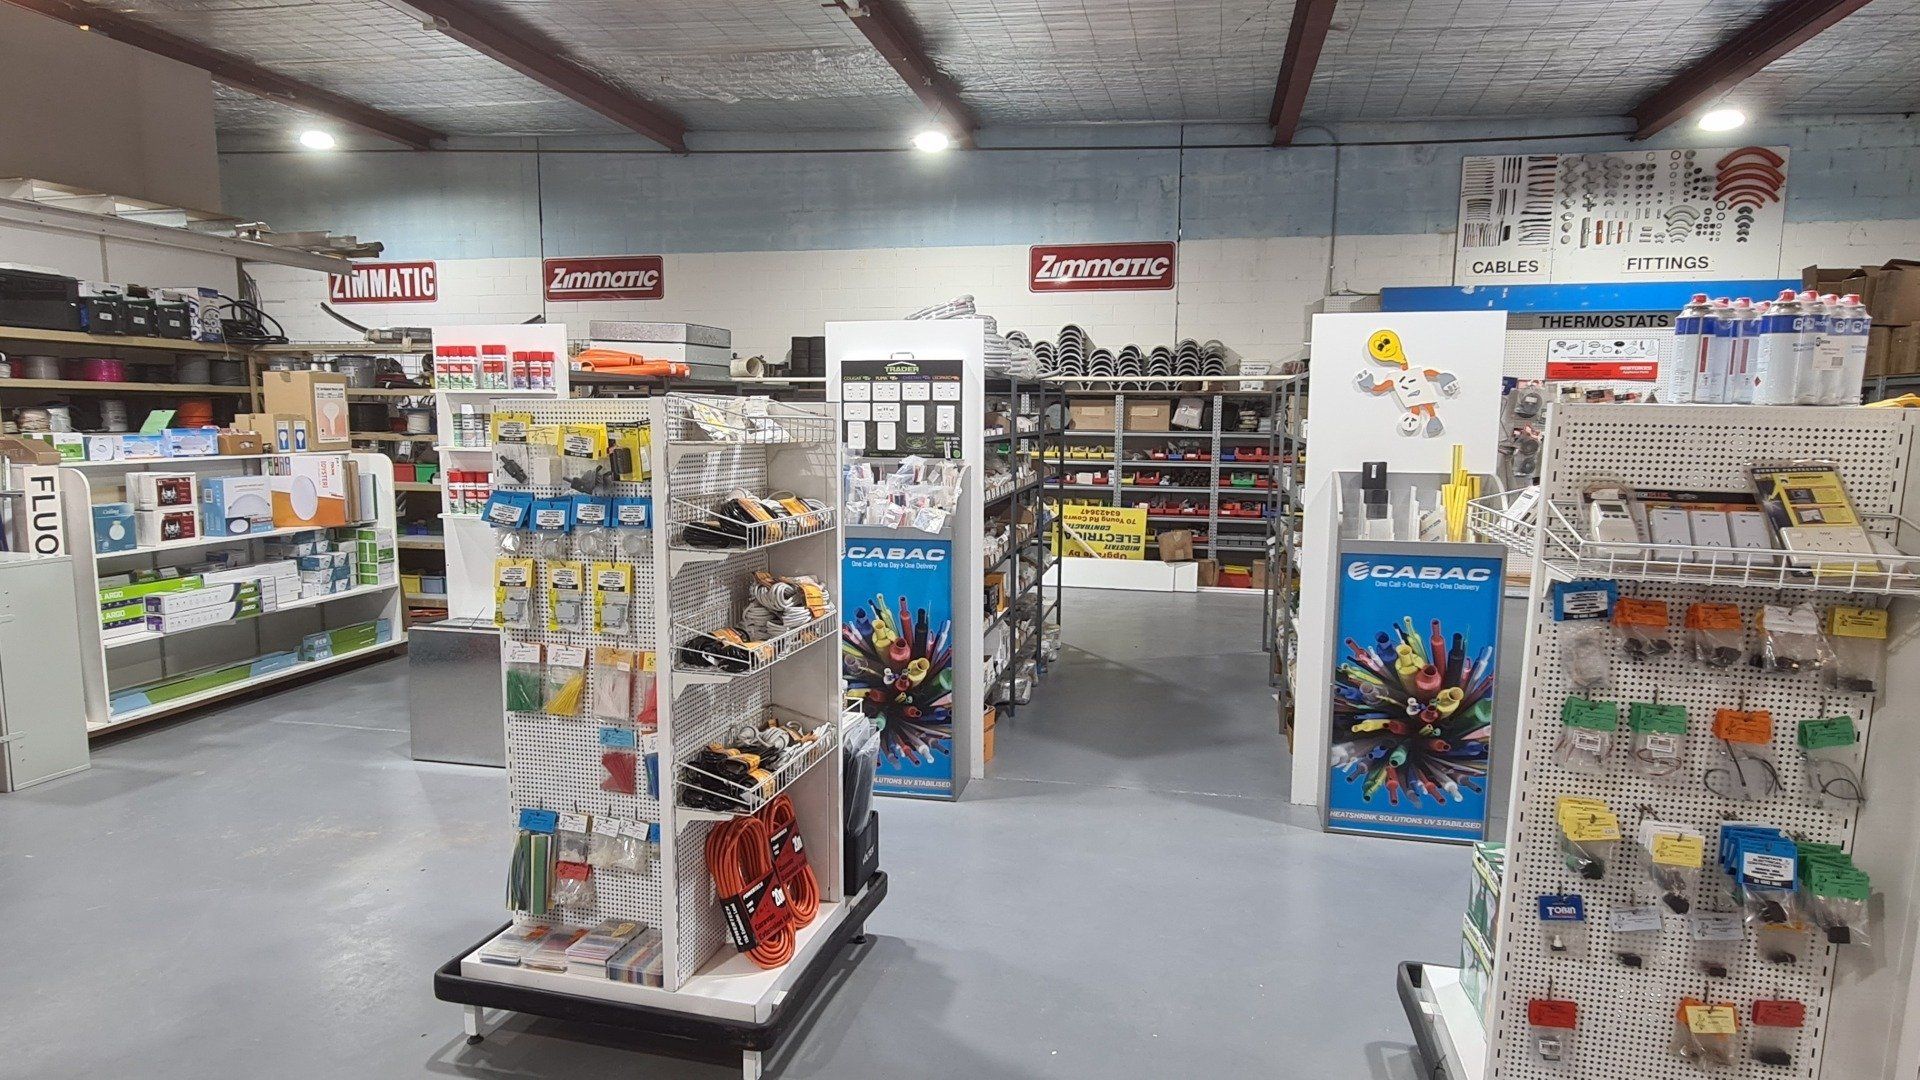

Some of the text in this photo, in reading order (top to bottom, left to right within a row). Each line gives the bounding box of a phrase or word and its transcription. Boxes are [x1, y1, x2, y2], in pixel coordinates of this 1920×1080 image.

[1472, 260, 1540, 274] CABLES
[1626, 256, 1709, 271] FITTINGS
[331, 265, 435, 299] ZIMMATIC
[1539, 315, 1669, 329] THERMOSTATS
[31, 476, 60, 555] FLUO
[1101, 516, 1125, 525] Young
[1065, 523, 1111, 531] CONTRACTI
[1058, 530, 1141, 544] ELECTRICA
[847, 546, 946, 562] CABAC
[889, 562, 900, 570] Day
[916, 562, 937, 571] Delivery
[1370, 565, 1491, 581] CABAC
[1421, 582, 1434, 590] Day
[1454, 583, 1479, 592] Delivery
[873, 777, 902, 785] LUTIONS
[913, 779, 951, 788] STABILISED
[1330, 810, 1482, 830] HEATSHRINK SOLUTIONS UV STABILISED
